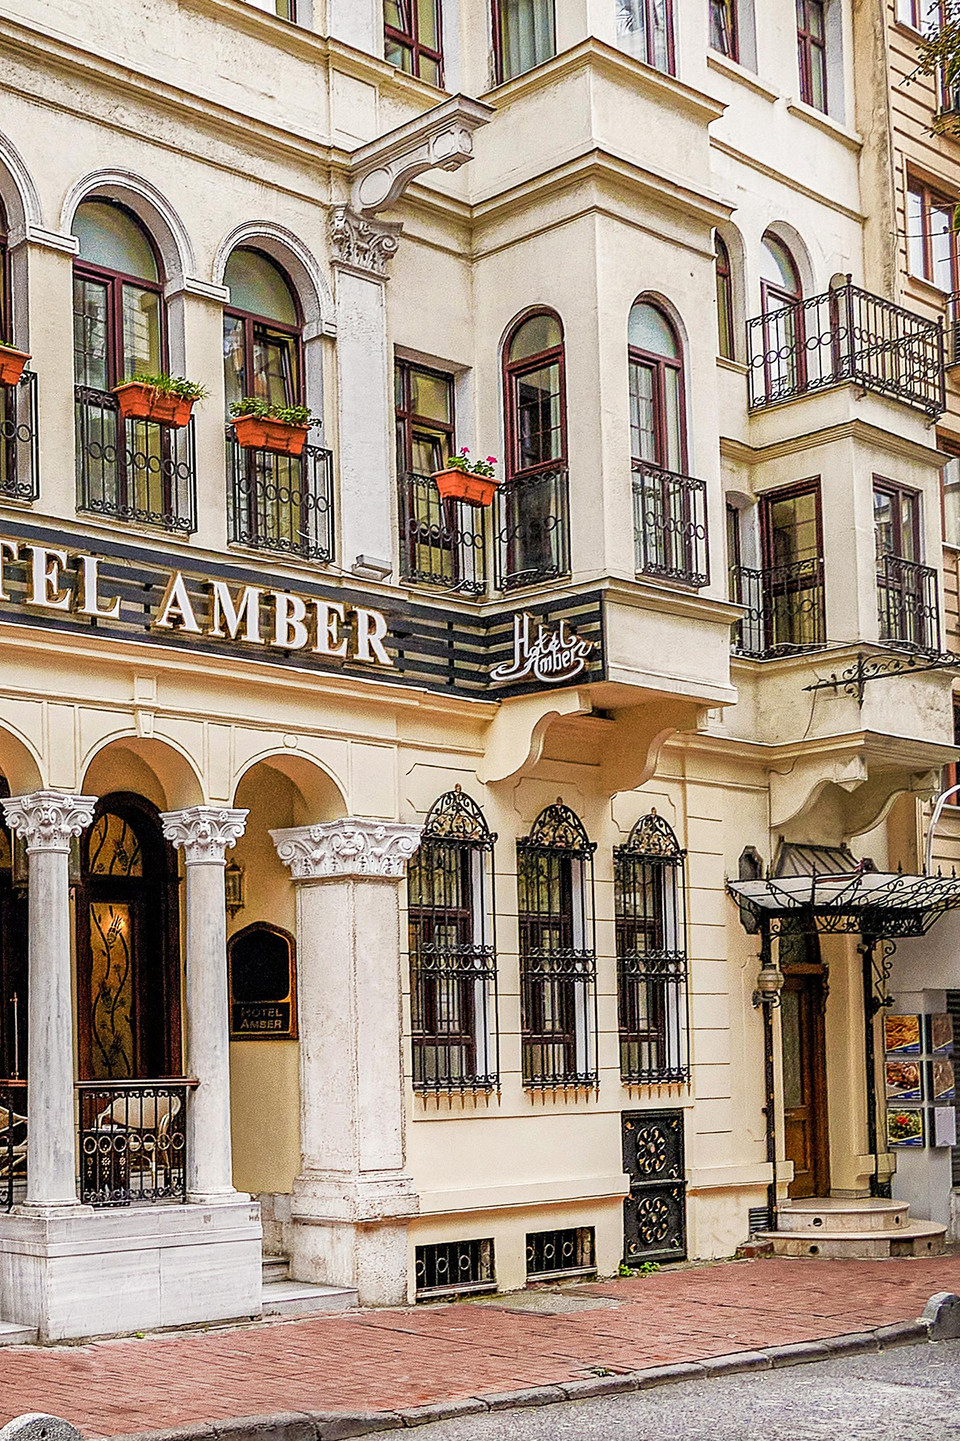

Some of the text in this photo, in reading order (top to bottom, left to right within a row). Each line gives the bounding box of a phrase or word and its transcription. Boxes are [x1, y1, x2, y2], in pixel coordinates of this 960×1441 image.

[152, 569, 396, 666] AMBER
[497, 612, 578, 675] Hotel
[490, 639, 594, 683] Amber
[240, 1007, 283, 1017] HOTEL
